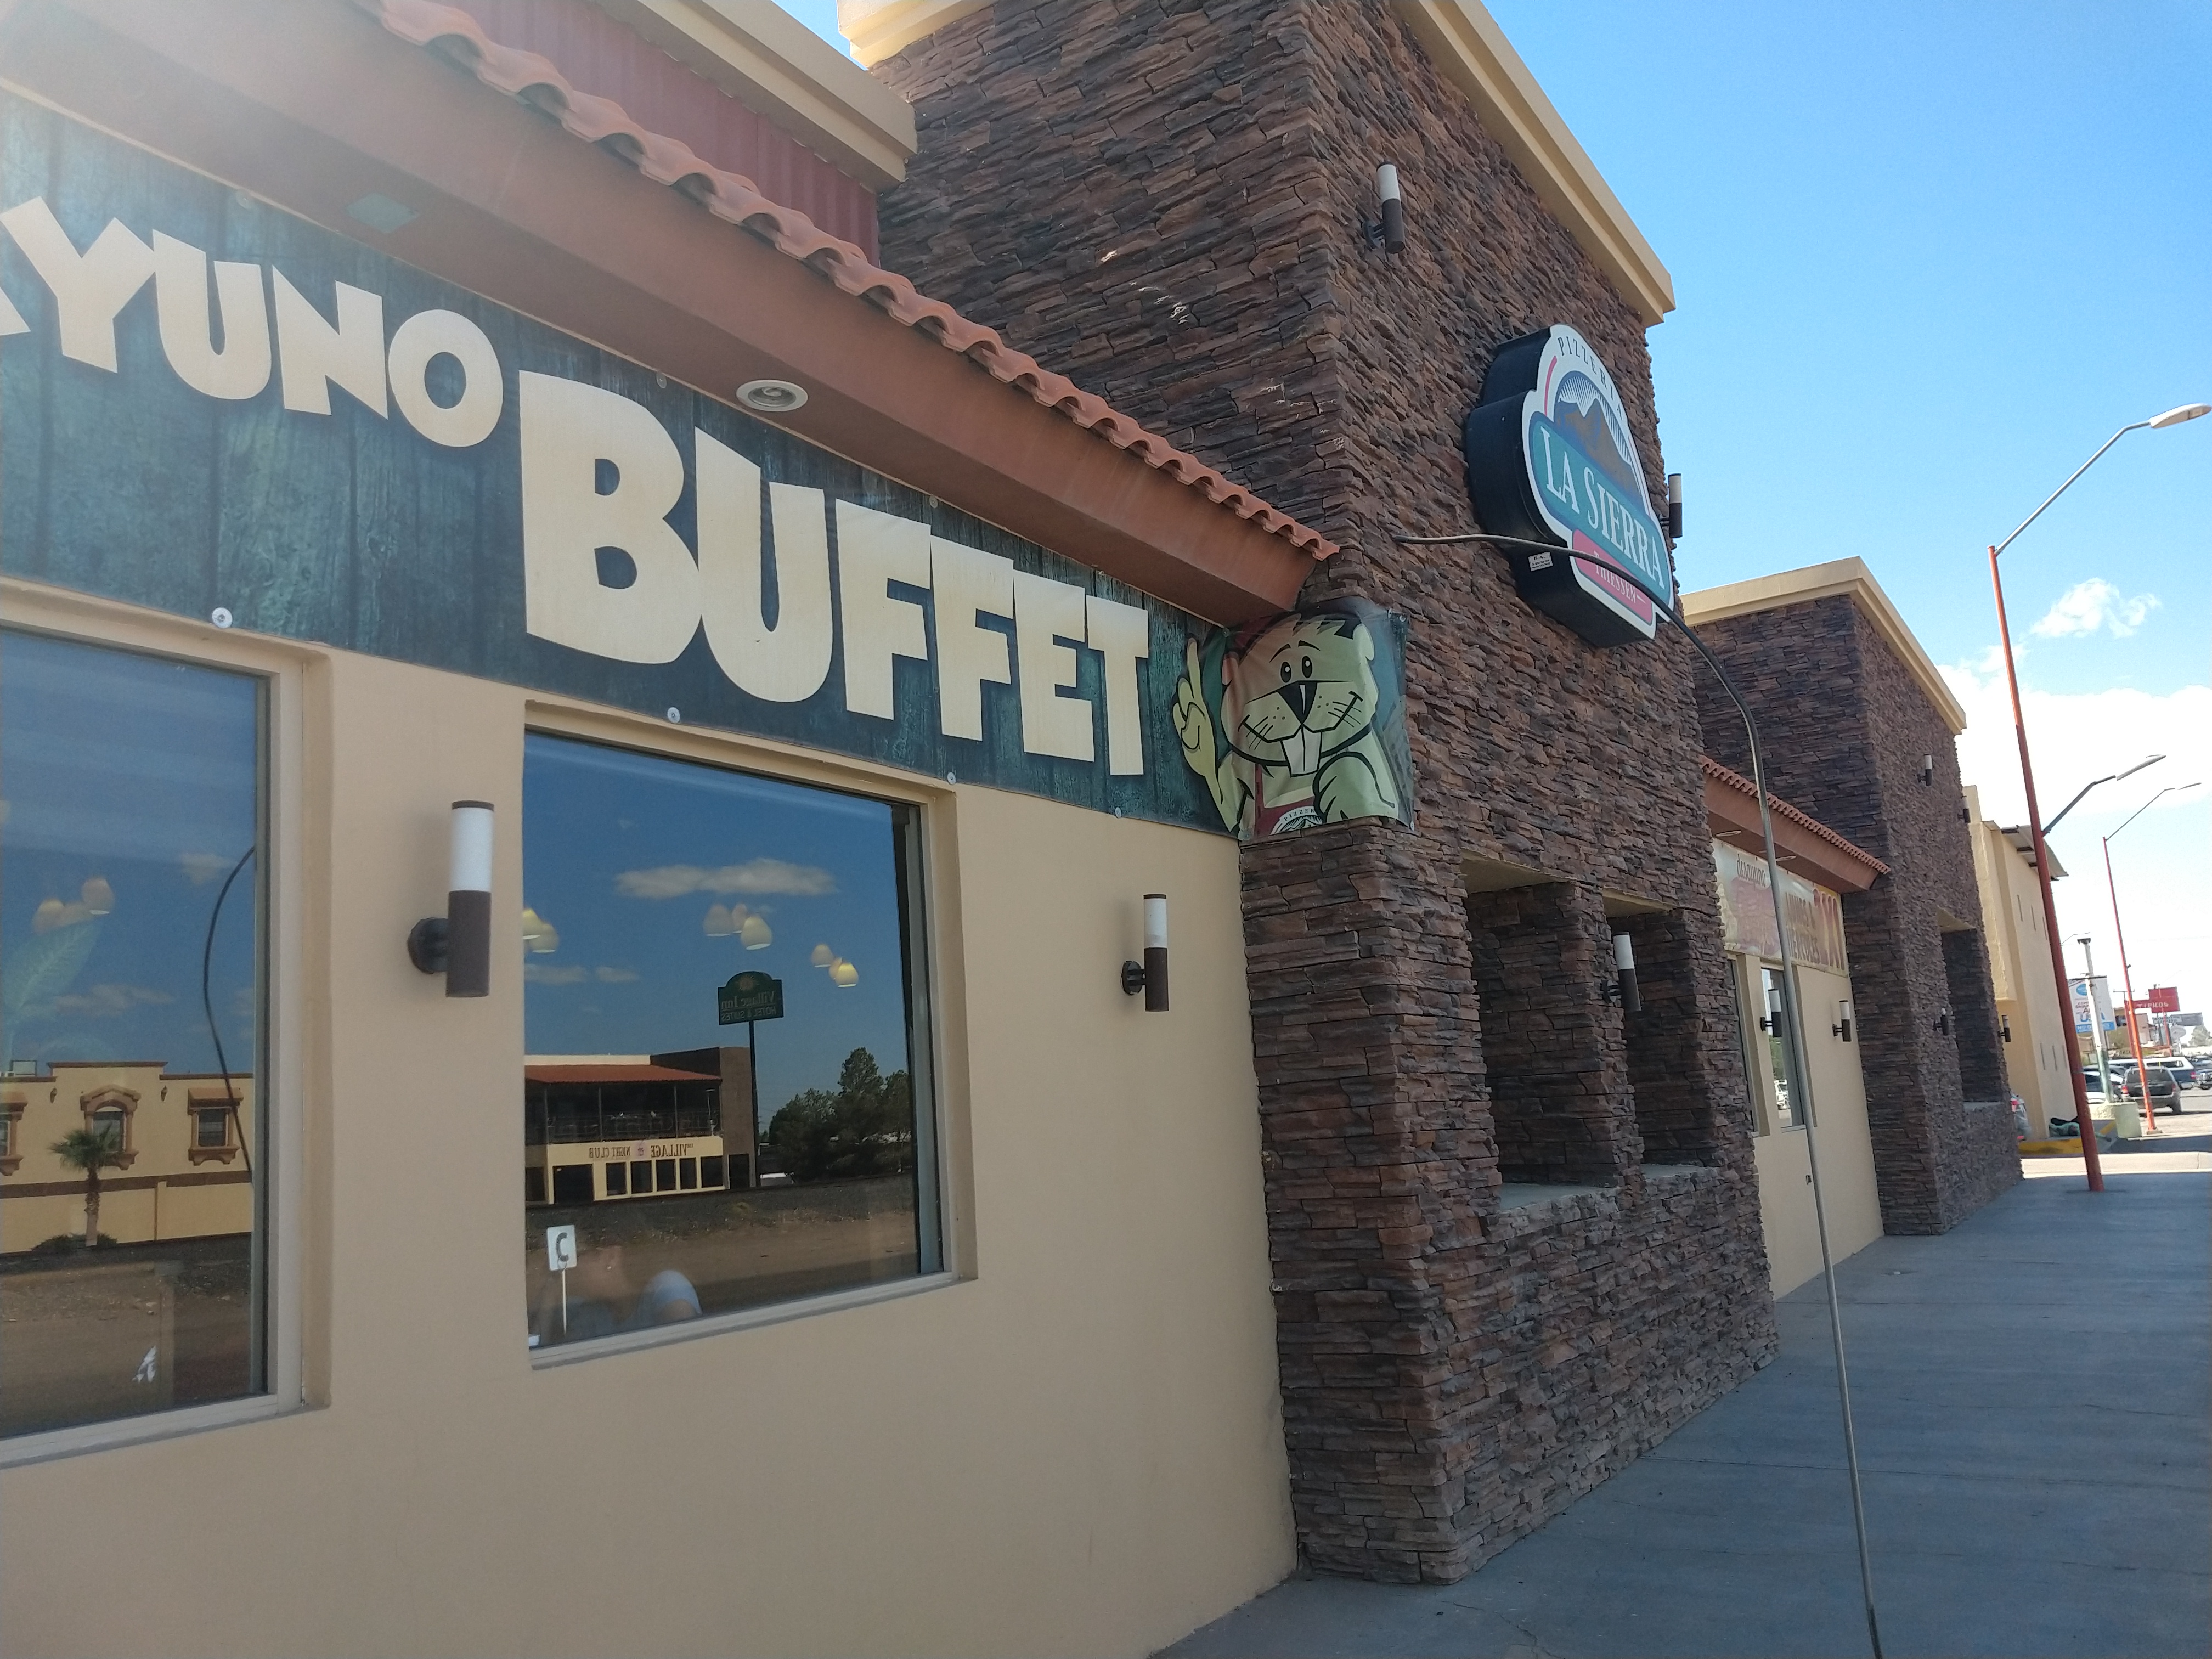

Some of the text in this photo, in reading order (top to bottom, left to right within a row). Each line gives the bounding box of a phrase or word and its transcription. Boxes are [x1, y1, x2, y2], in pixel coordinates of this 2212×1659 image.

[1558, 336, 1622, 421] PIZZERIA
[1541, 426, 1664, 590] LA SIERRA
[519, 370, 1149, 776] BUFFET
[1593, 550, 1636, 603] THIESSEN
[1736, 853, 1766, 888] desayuno
